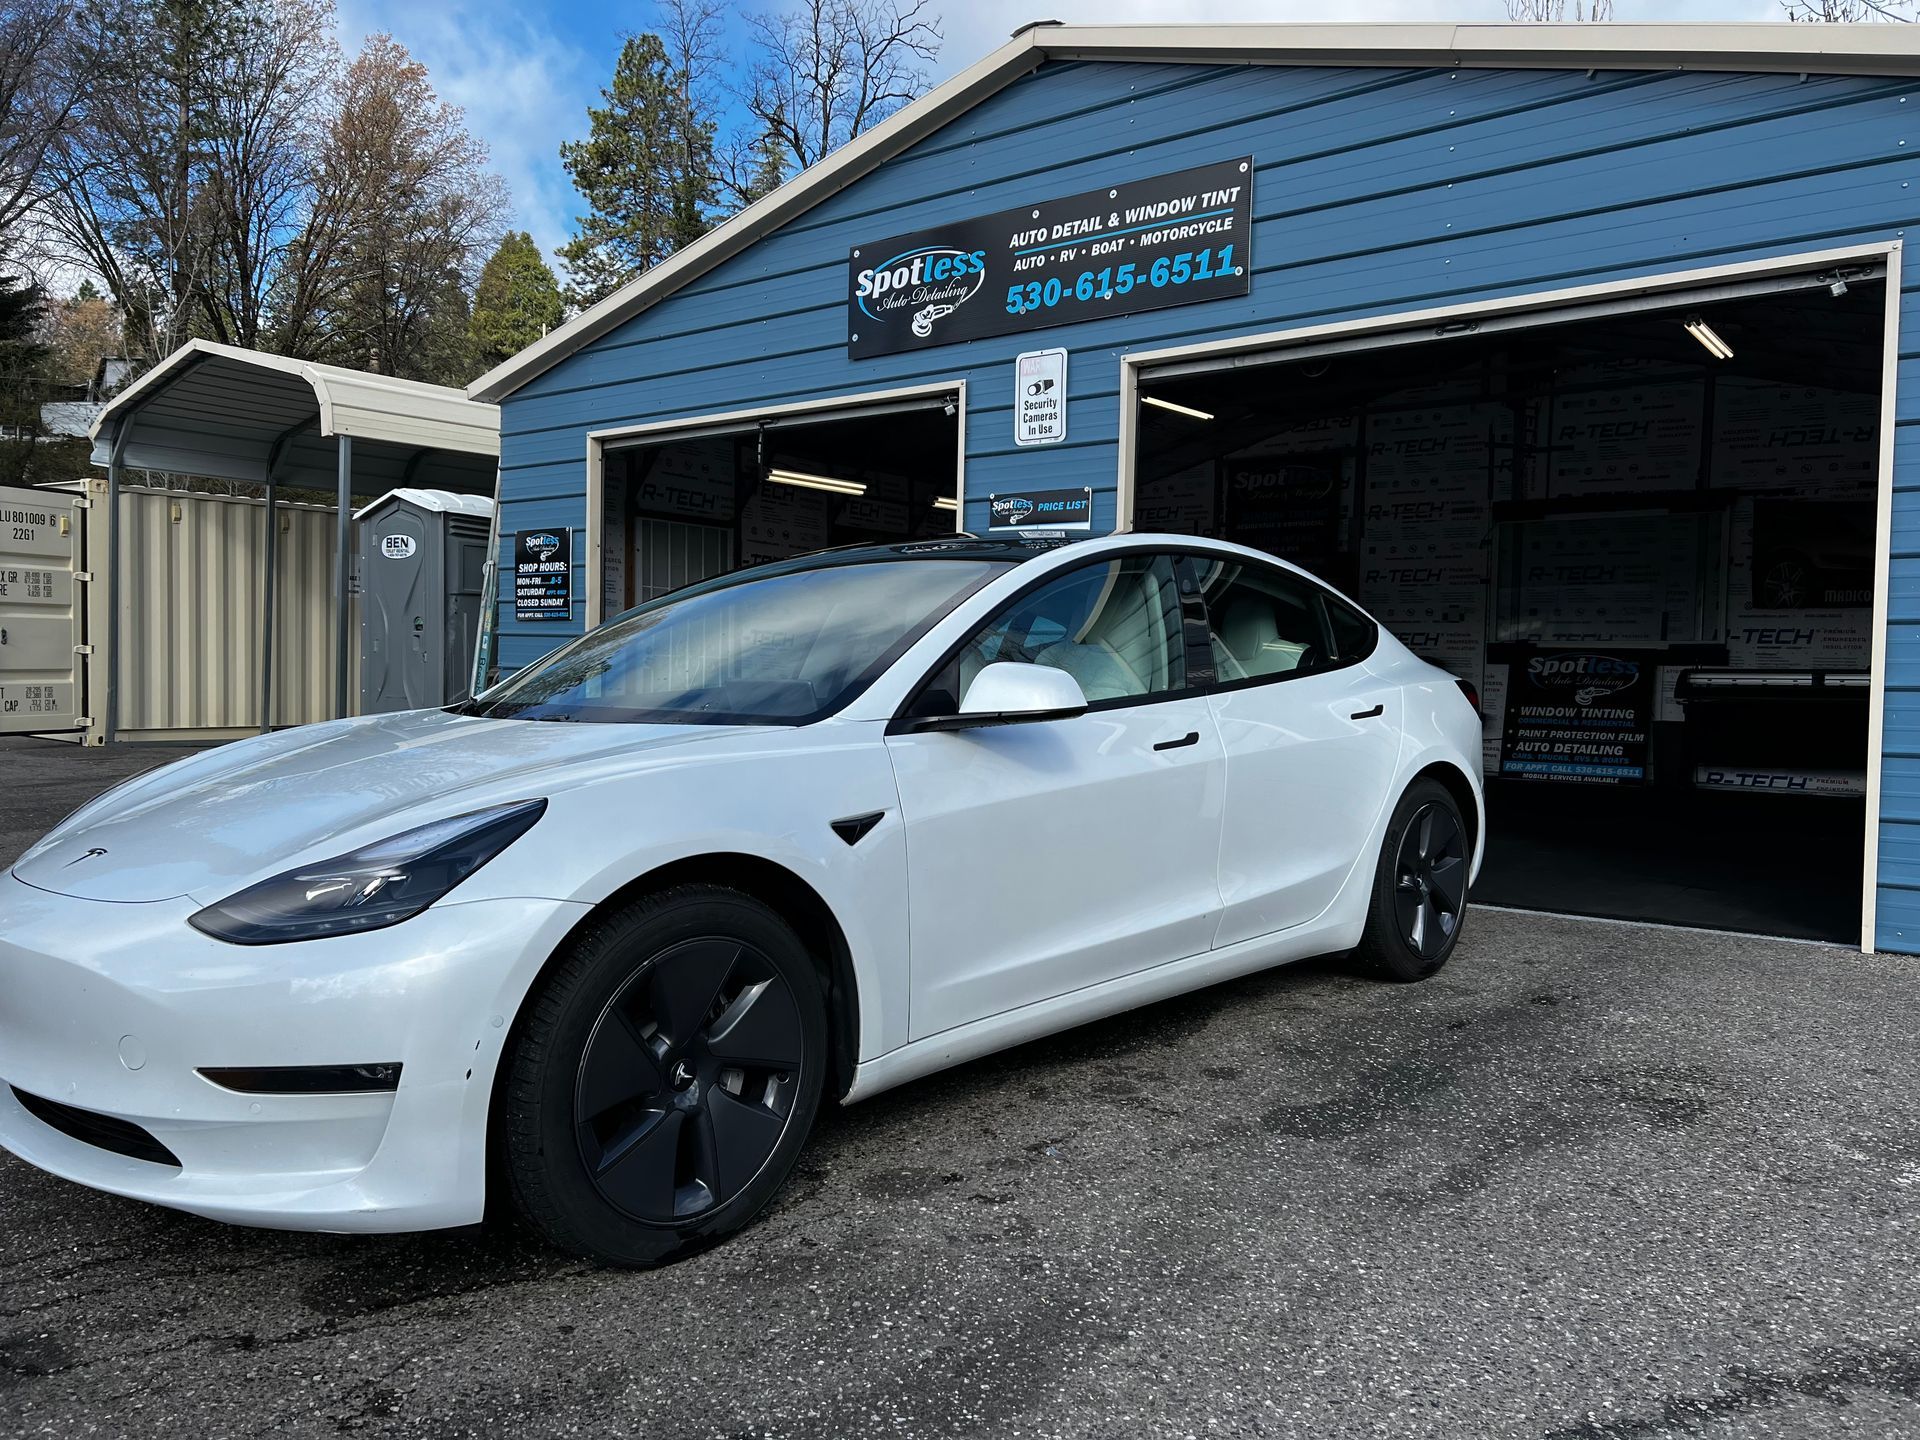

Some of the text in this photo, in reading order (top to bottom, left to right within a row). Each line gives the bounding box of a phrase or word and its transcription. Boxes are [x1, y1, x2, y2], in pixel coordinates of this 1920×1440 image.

[1009, 186, 1241, 248] AUTO DETAIL & WINDOW TINT
[1013, 217, 1234, 271] AUTO RV BOAT MOTORCYCLE
[855, 250, 986, 299] Spotless
[1006, 244, 1236, 314] 530-615-6511
[876, 276, 968, 311] Auto Detailing
[1024, 398, 1058, 411] Security
[1023, 411, 1058, 424] Cameras
[1028, 424, 1053, 435] In Use
[1559, 421, 1648, 440] R-TECH
[642, 484, 716, 510] R-TECH
[992, 500, 1033, 511] Spotless
[1037, 500, 1087, 512] PRICE LIST
[12, 511, 45, 525] 801009
[50, 514, 56, 527] 6
[13, 528, 34, 541] 22G1
[386, 536, 409, 548] BEN
[525, 536, 559, 548] Spotless
[518, 562, 567, 573] SHOP HOURS:
[1528, 565, 1617, 581] R-TECH
[1365, 568, 1442, 583] R-TECH
[517, 588, 546, 596] SATURDAY
[517, 598, 564, 607] CLOSED SUNDAY
[1727, 629, 1814, 644] -TECH
[1528, 656, 1640, 676] Spotless
[1520, 706, 1635, 719] WINDOW TINTING
[1518, 718, 1570, 726] COMMERCIAL
[1582, 719, 1635, 727] RESIDENTIAL
[1518, 729, 1645, 742] PAINT PROTECTION FILM
[1516, 742, 1624, 756] AUTO DETAILING
[1505, 762, 1640, 777] FOR APPT. CALL 530-615-6511
[1522, 772, 1620, 784] MOBILE SERVICES AVAILABLE
